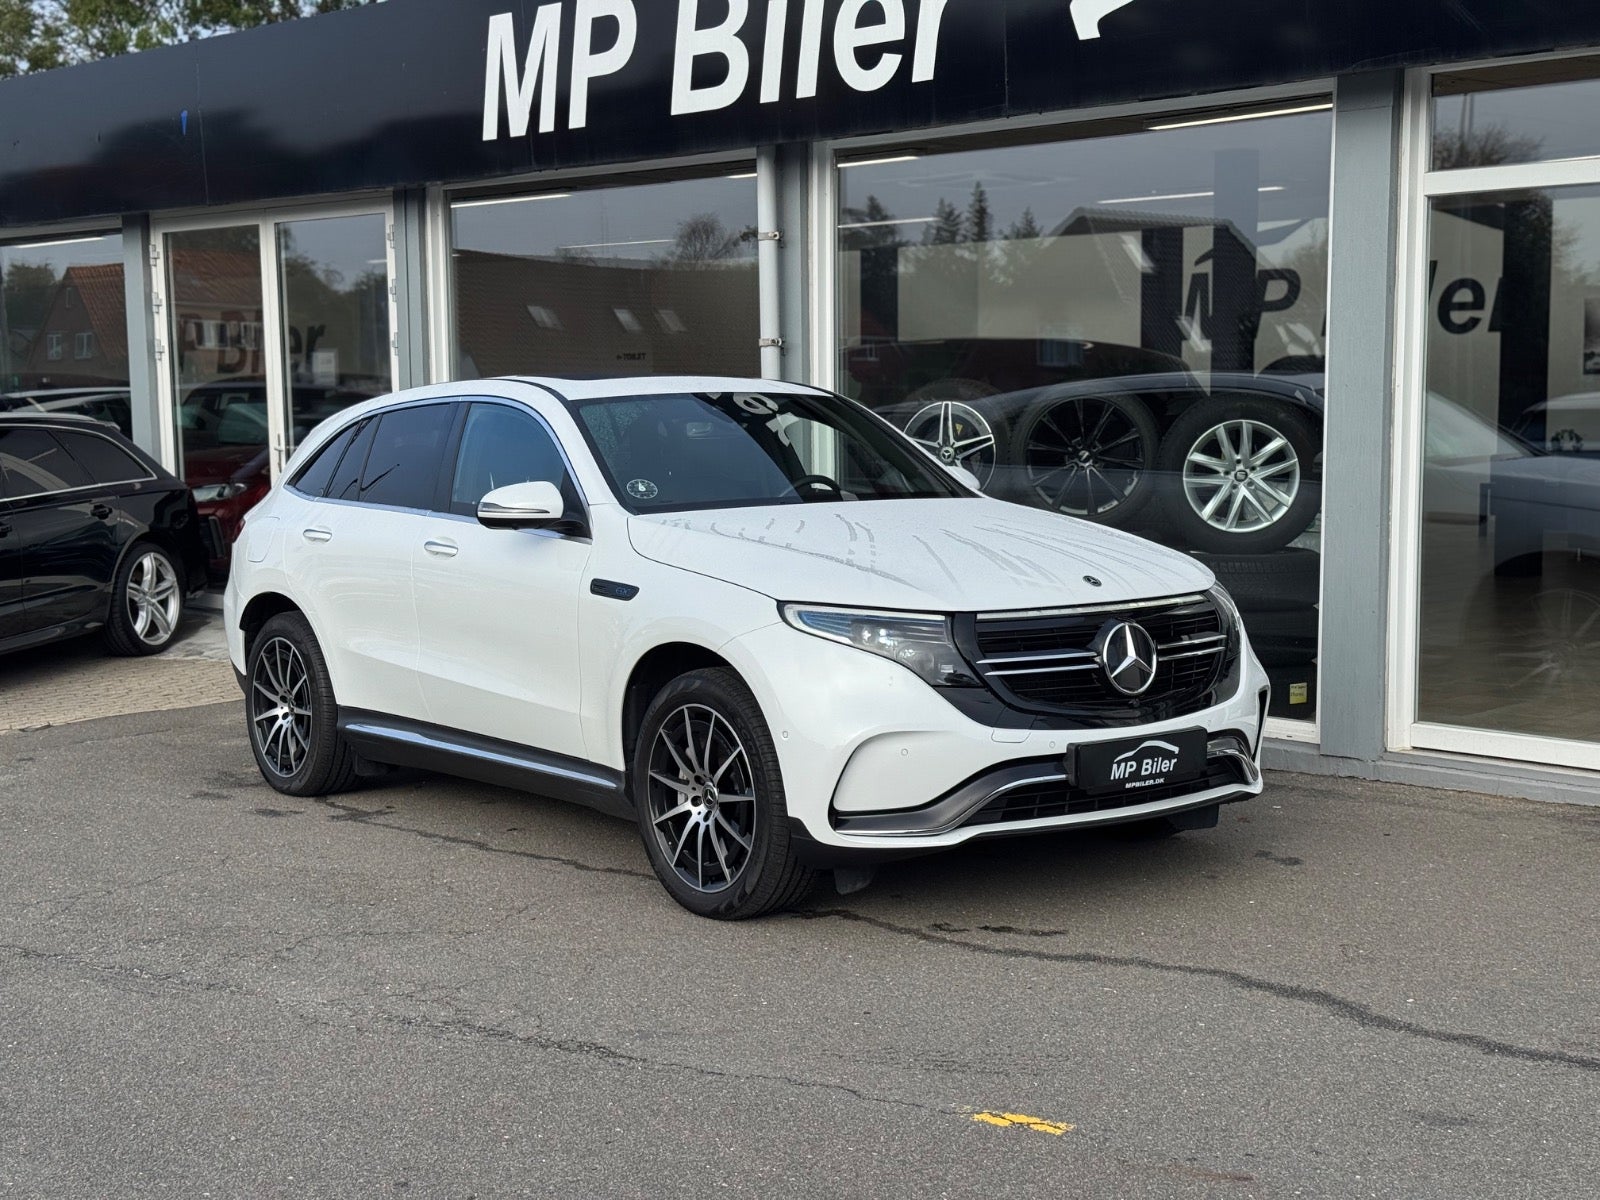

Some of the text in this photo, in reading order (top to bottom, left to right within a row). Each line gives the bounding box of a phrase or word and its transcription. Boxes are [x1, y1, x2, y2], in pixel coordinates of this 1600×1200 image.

[482, 0, 948, 141] MP Biler
[1110, 757, 1178, 780] MP Biler
[1125, 777, 1165, 789] MPBILER.DK
